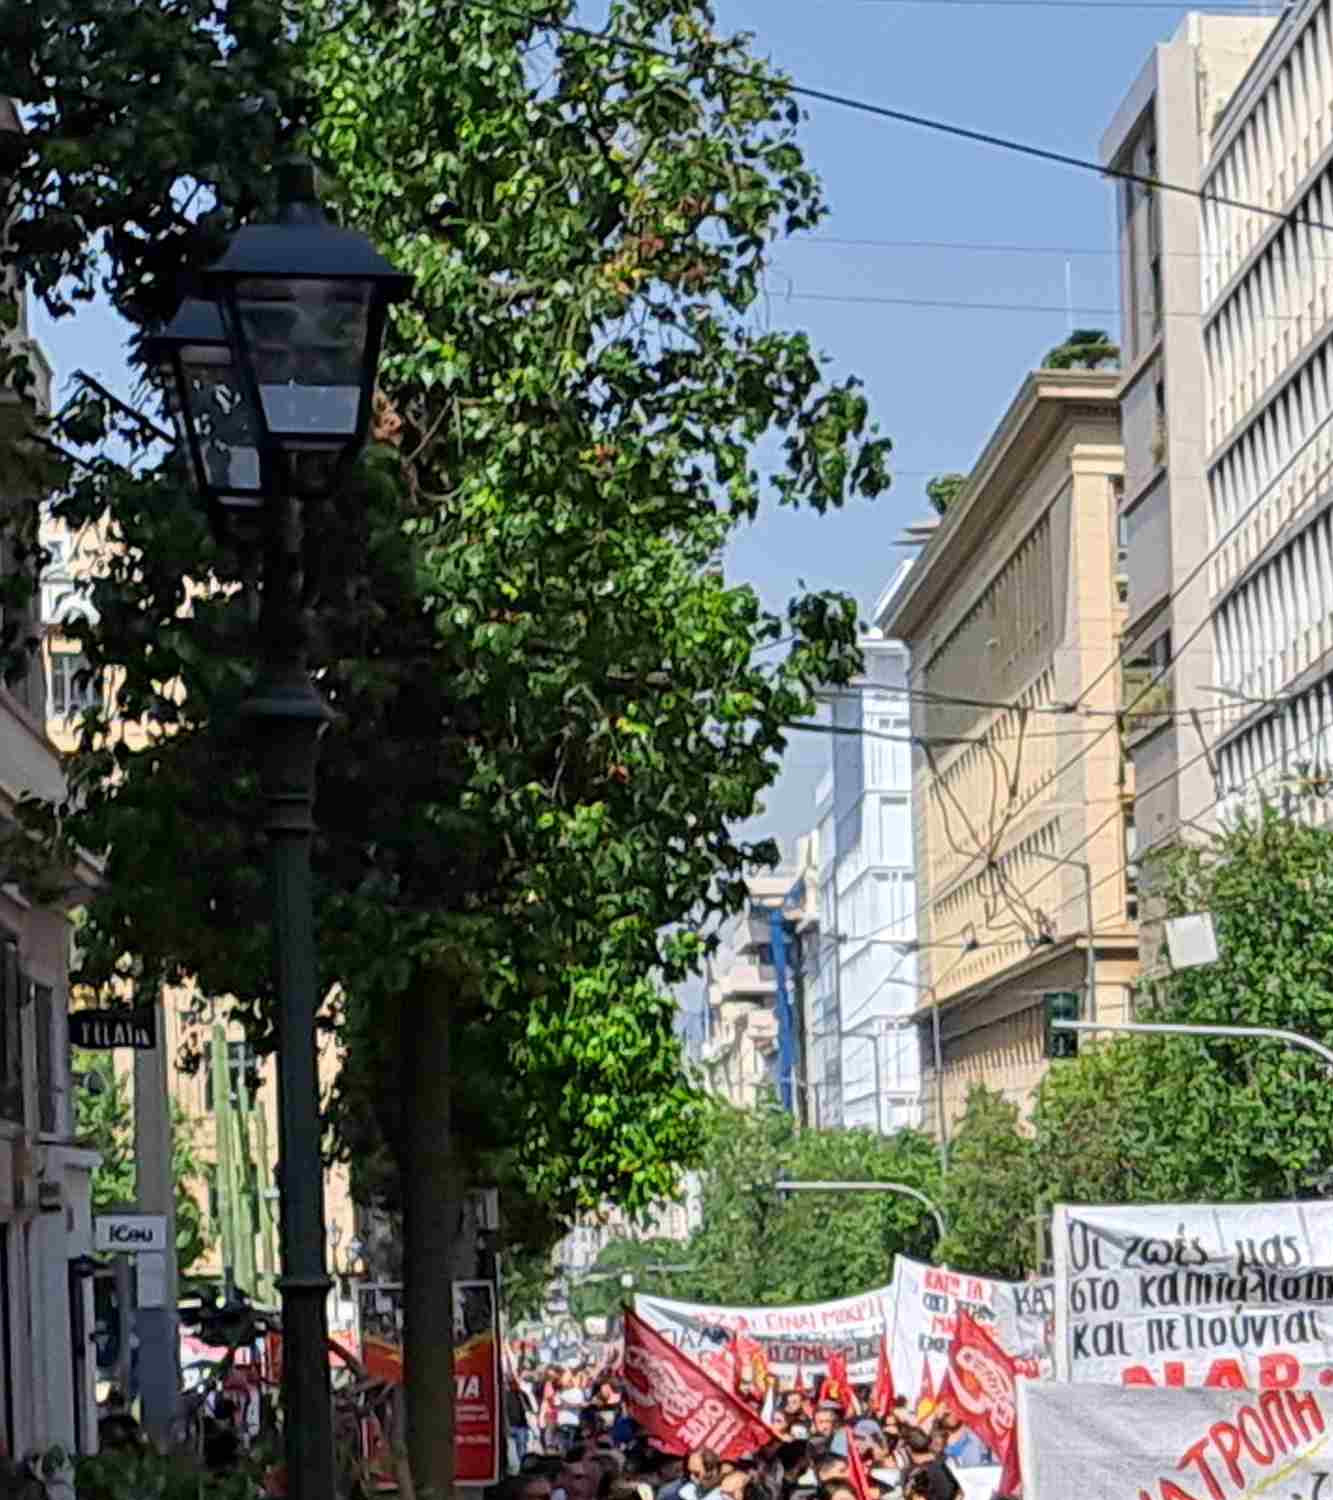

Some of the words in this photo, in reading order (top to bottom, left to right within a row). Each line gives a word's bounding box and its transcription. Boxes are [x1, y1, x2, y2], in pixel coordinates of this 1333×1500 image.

[1235, 1232, 1300, 1275] μας
[1071, 1277, 1119, 1313] στο
[1073, 1319, 1128, 1359] και
